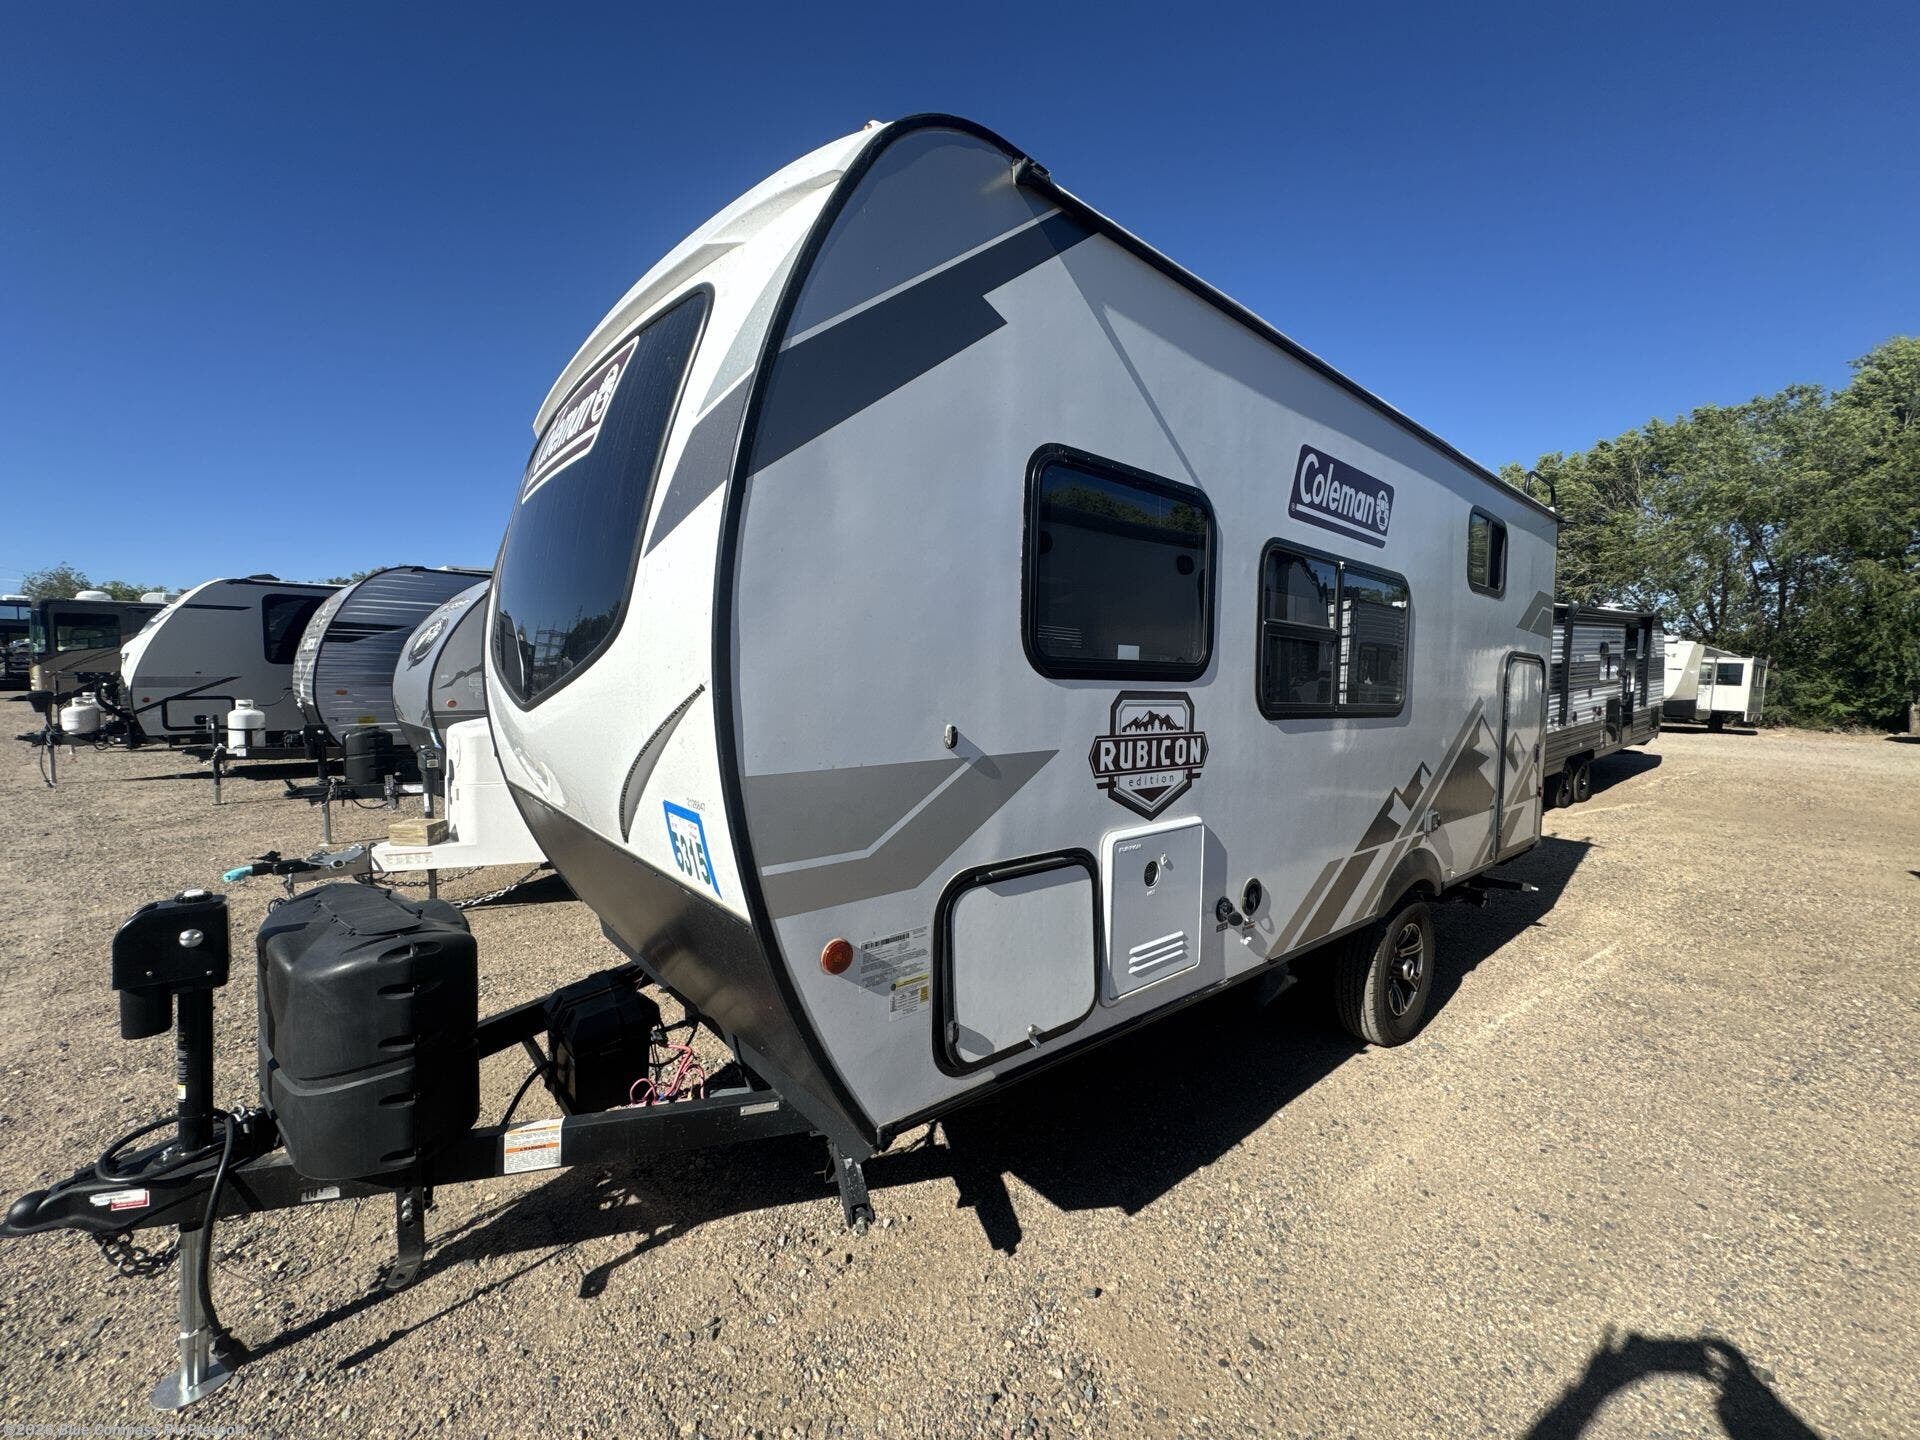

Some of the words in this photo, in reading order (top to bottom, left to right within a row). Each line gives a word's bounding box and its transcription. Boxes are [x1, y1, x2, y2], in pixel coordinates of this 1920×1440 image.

[1299, 453, 1375, 525] Coleman
[1099, 738, 1201, 772] RUBICON
[1128, 774, 1175, 787] edition
